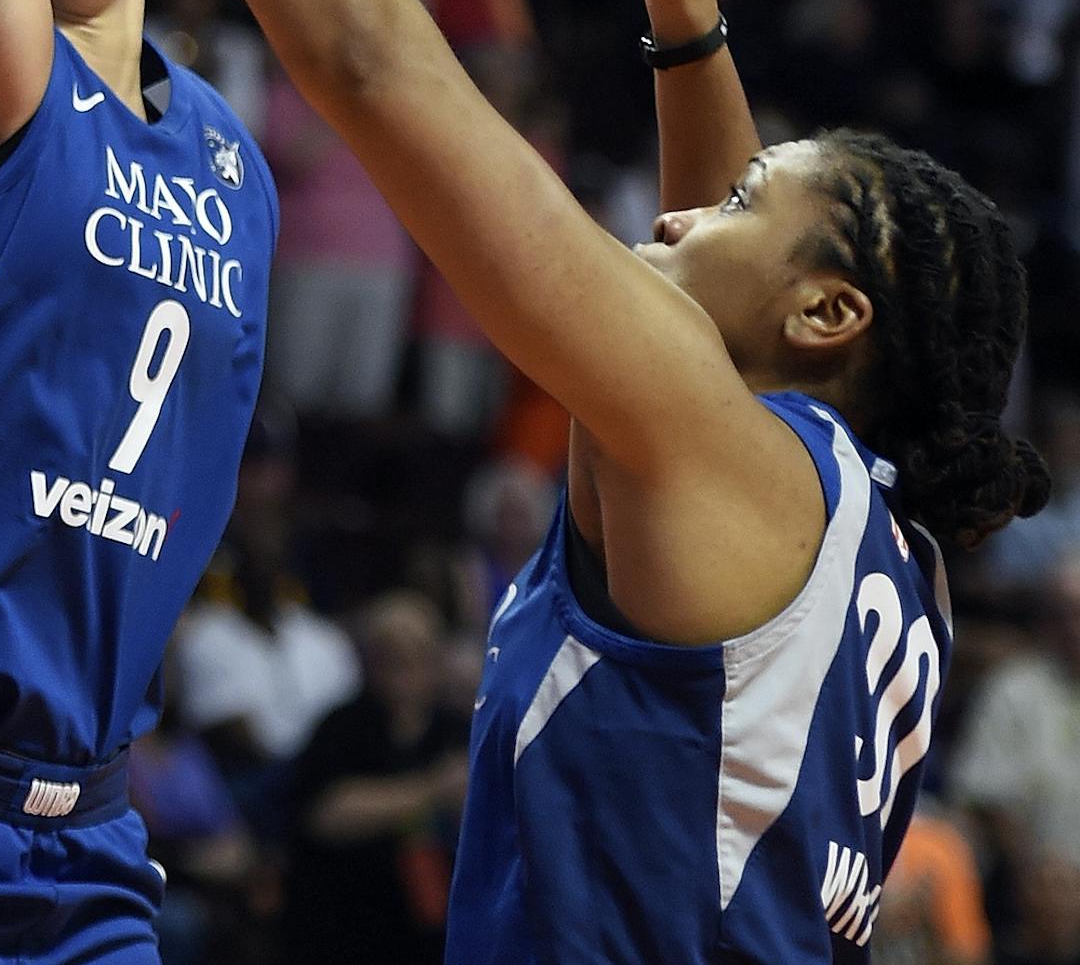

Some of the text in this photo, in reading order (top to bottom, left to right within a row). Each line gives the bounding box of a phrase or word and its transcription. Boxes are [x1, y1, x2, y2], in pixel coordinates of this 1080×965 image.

[84, 207, 244, 318] CLINIC
[108, 299, 191, 475] 9
[856, 572, 940, 832] 30
